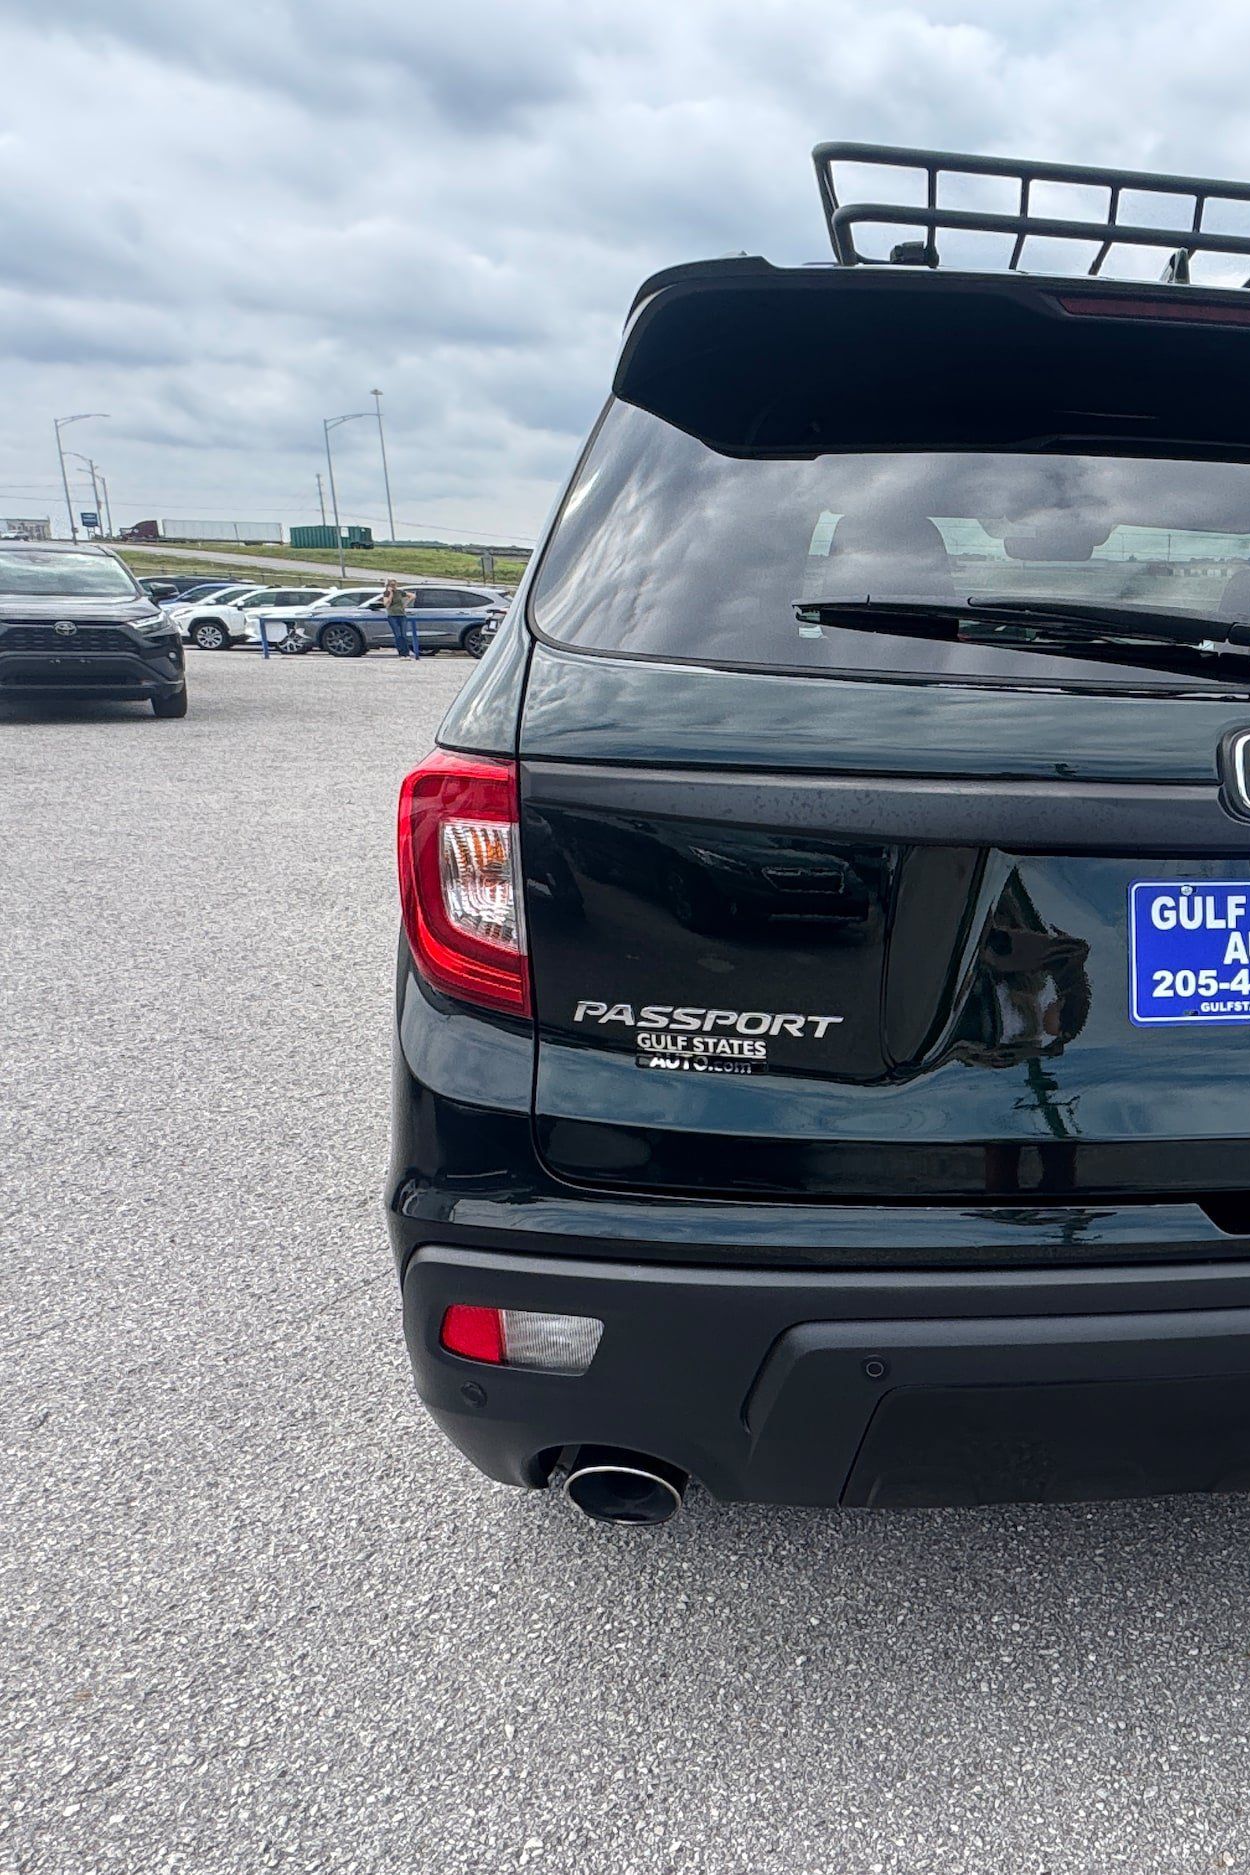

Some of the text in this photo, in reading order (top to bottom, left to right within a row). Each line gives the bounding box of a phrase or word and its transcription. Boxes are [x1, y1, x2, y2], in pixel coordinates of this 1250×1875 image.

[1151, 895, 1247, 930] GULF
[573, 1000, 844, 1039] PASSPORT
[637, 1033, 767, 1056] GULF STATES
